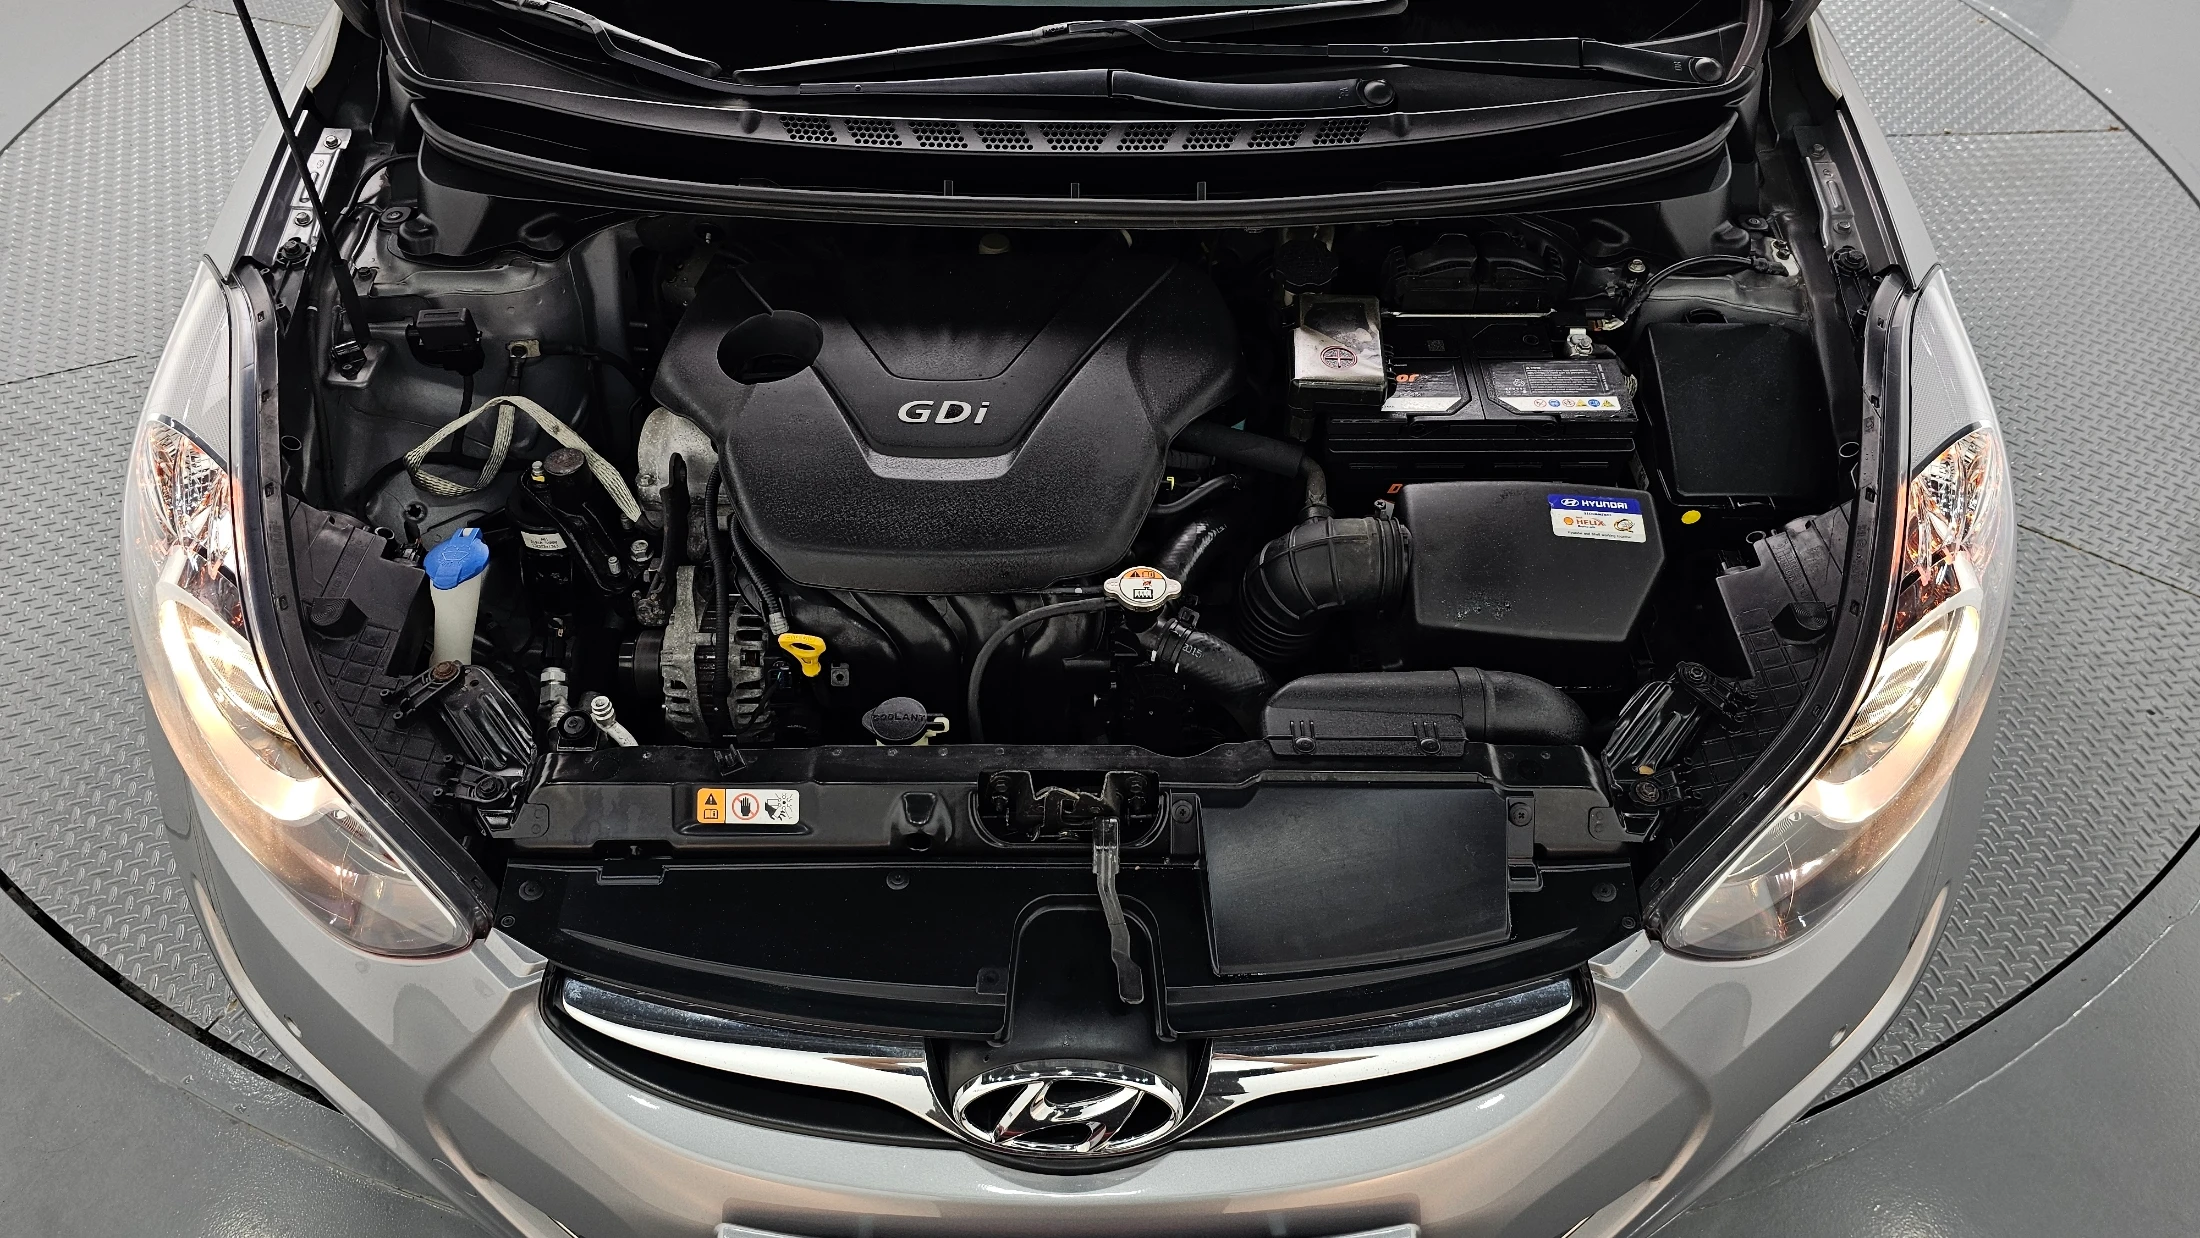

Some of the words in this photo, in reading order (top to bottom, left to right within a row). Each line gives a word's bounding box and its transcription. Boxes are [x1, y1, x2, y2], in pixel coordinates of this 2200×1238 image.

[897, 400, 990, 424] GDi
[1581, 499, 1628, 510] HYUNDAI
[1576, 518, 1605, 527] HELIX
[871, 713, 926, 722] COOLANT
